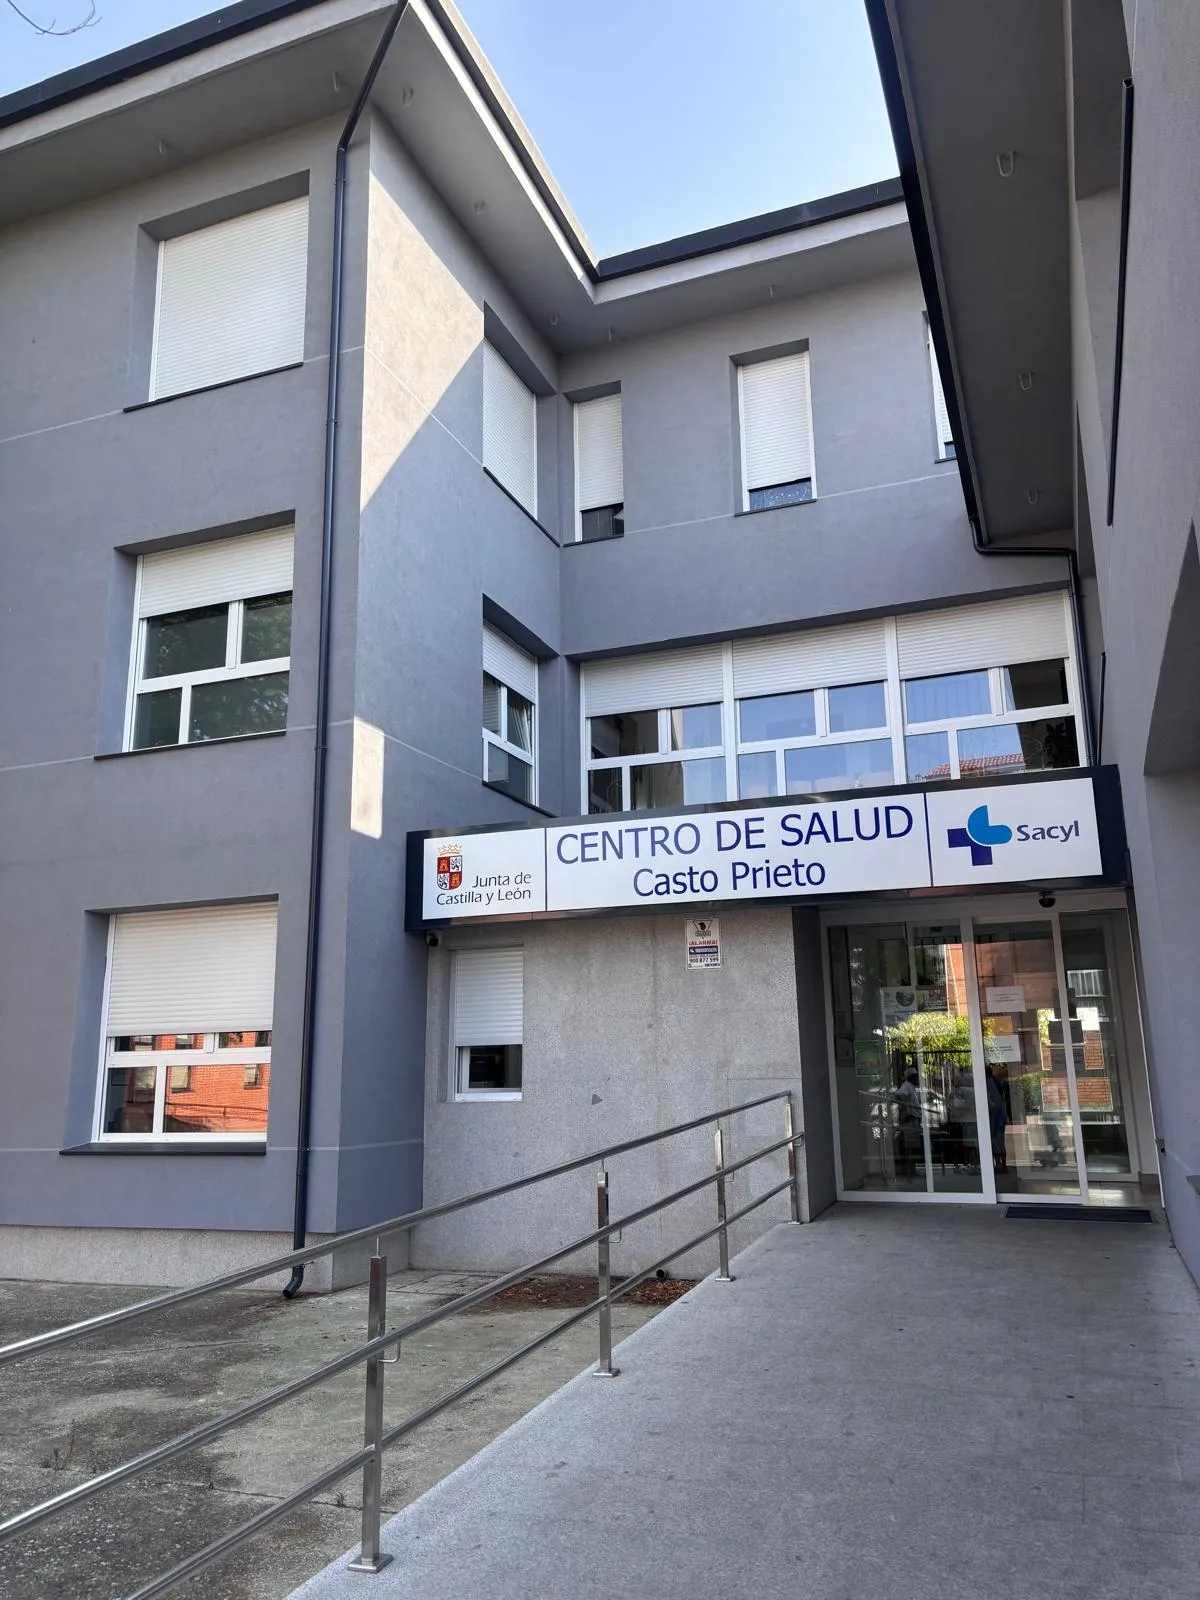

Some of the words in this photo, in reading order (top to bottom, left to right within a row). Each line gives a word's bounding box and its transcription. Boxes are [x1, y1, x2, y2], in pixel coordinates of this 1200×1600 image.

[556, 822, 701, 865] CENTRO
[716, 816, 767, 852] DE
[780, 805, 914, 847] SALUD
[1016, 820, 1080, 843] Sacyl
[472, 874, 510, 888] Junta
[514, 872, 532, 885] de
[633, 865, 719, 897] Casto
[731, 858, 826, 891] Prieto
[436, 891, 482, 906] Castilla
[485, 892, 494, 905] y
[498, 887, 532, 901] León
